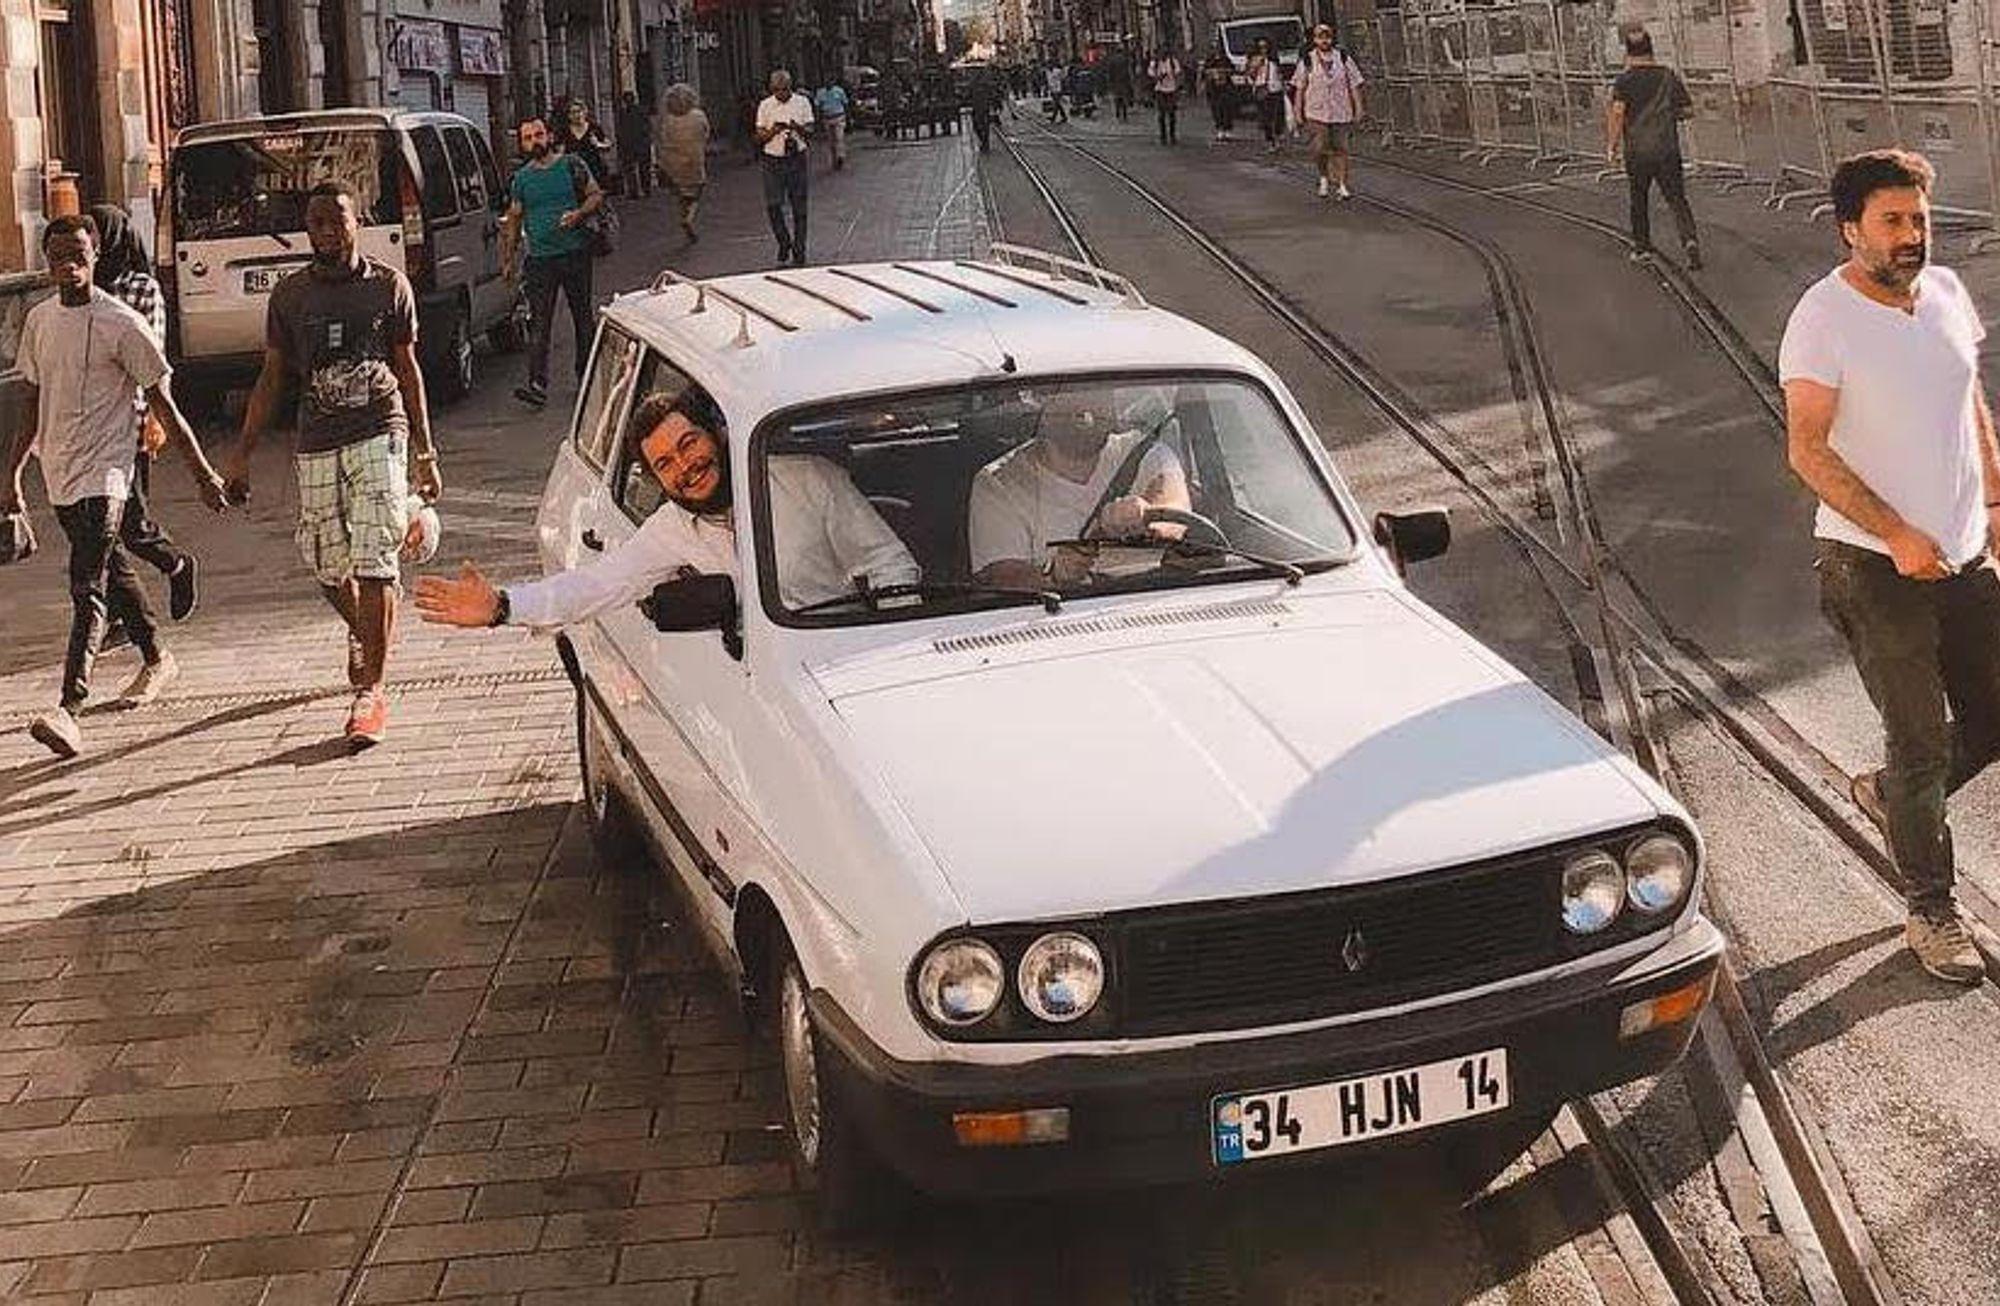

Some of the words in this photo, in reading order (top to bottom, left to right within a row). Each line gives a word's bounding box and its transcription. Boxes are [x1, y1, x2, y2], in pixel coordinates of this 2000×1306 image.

[1244, 1095, 1302, 1151] 34
[1339, 1072, 1422, 1136] HJN
[1458, 1056, 1500, 1110] 14
[1220, 1133, 1240, 1149] TR
